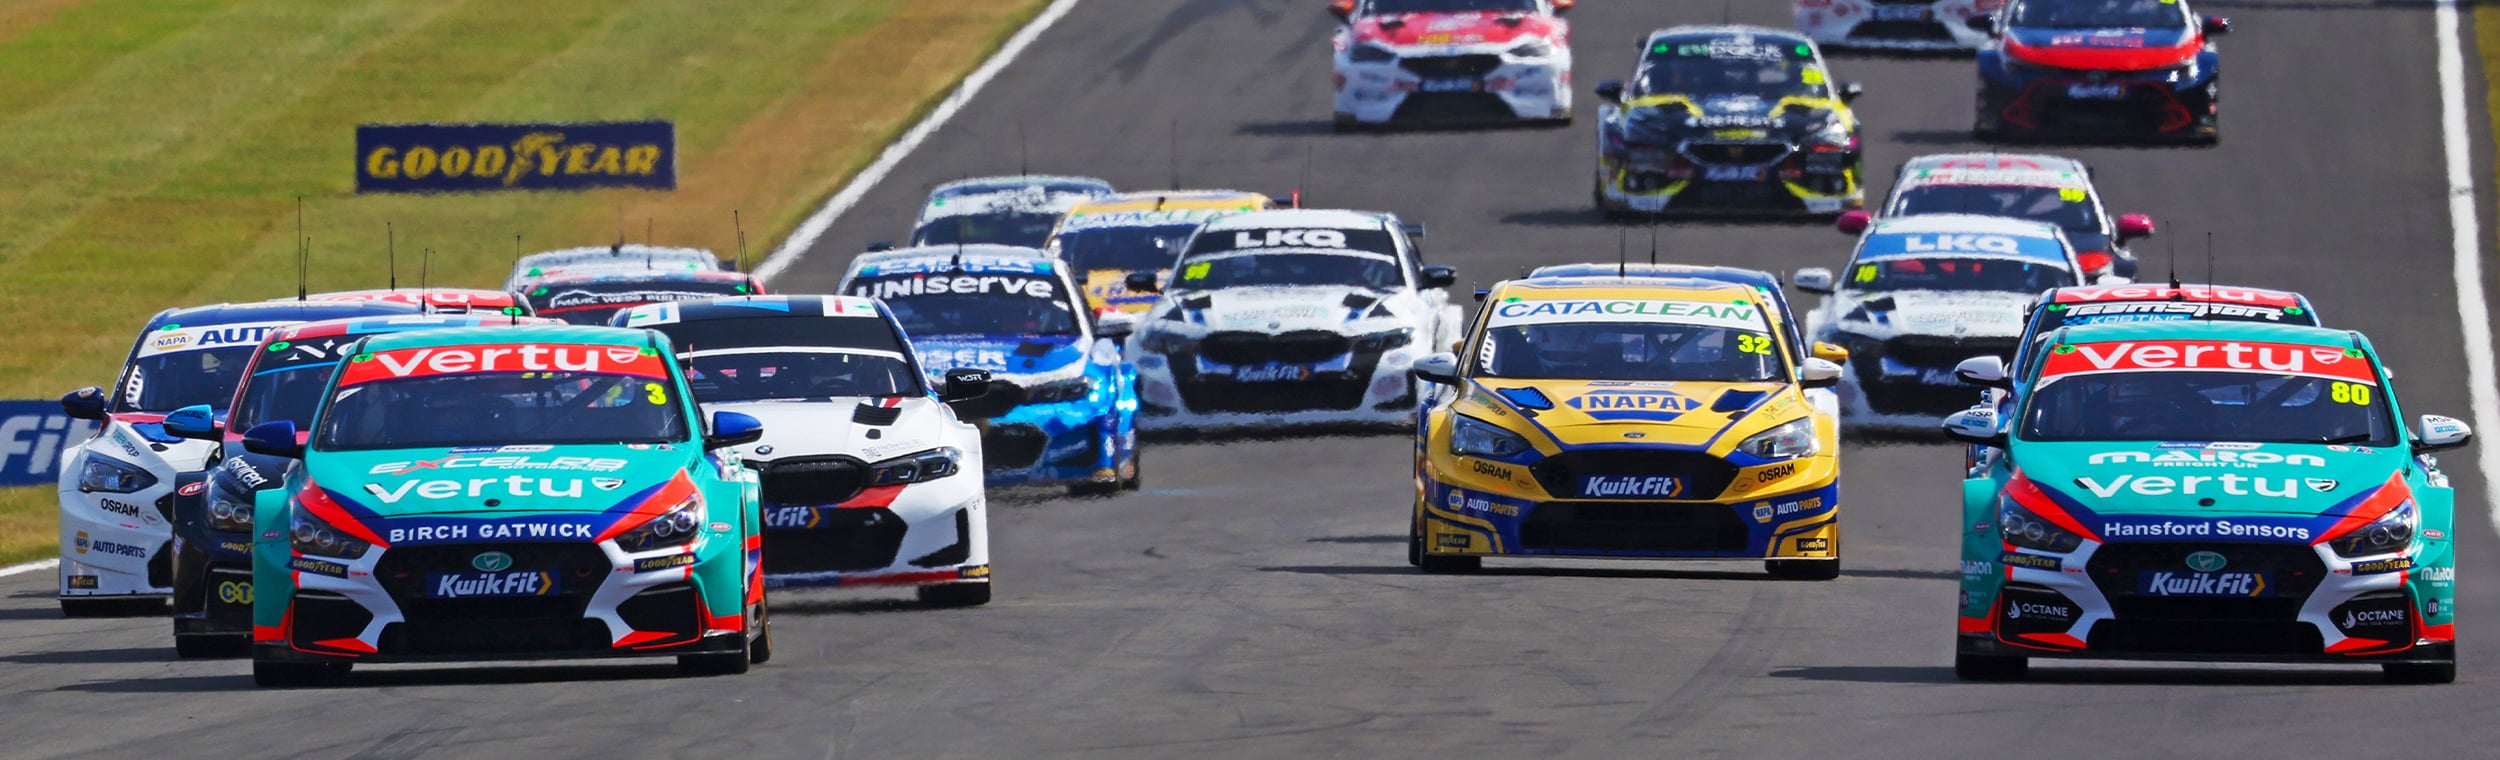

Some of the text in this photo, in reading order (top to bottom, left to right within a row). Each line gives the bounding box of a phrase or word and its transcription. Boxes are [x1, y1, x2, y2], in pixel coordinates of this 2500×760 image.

[366, 134, 661, 185] GOODYEAR
[1236, 229, 1346, 248] LKQ
[1905, 235, 2020, 254] LKQ
[1498, 300, 1753, 321] CATACLEAN
[156, 336, 187, 348] NAPA
[1737, 334, 1772, 355] 32
[645, 382, 668, 406] 3
[1589, 395, 1681, 410] NAPA
[2331, 381, 2370, 406] 80
[1473, 460, 1512, 481] OSRAM
[1757, 463, 1795, 484] OSRAM
[101, 497, 140, 518] OSRAM
[1467, 498, 1489, 513] AUTO
[1489, 502, 1519, 517] PARTS
[1777, 501, 1799, 516] AUTO
[1799, 496, 1822, 511] PARTS
[389, 523, 593, 543] BIRCH GATWICK
[2104, 520, 2310, 540] Hansford Sensors
[93, 540, 116, 555] AUTO
[116, 543, 147, 559] PARTS
[220, 541, 253, 554] GOOD
[293, 559, 343, 575] GOODYEAR
[640, 554, 696, 570] GOODYEAR
[2002, 554, 2056, 569] GOODYEAR
[2357, 557, 2411, 572] GOODYEAR
[2021, 603, 2069, 617] OCTANE
[2357, 609, 2405, 621] OCTANE
